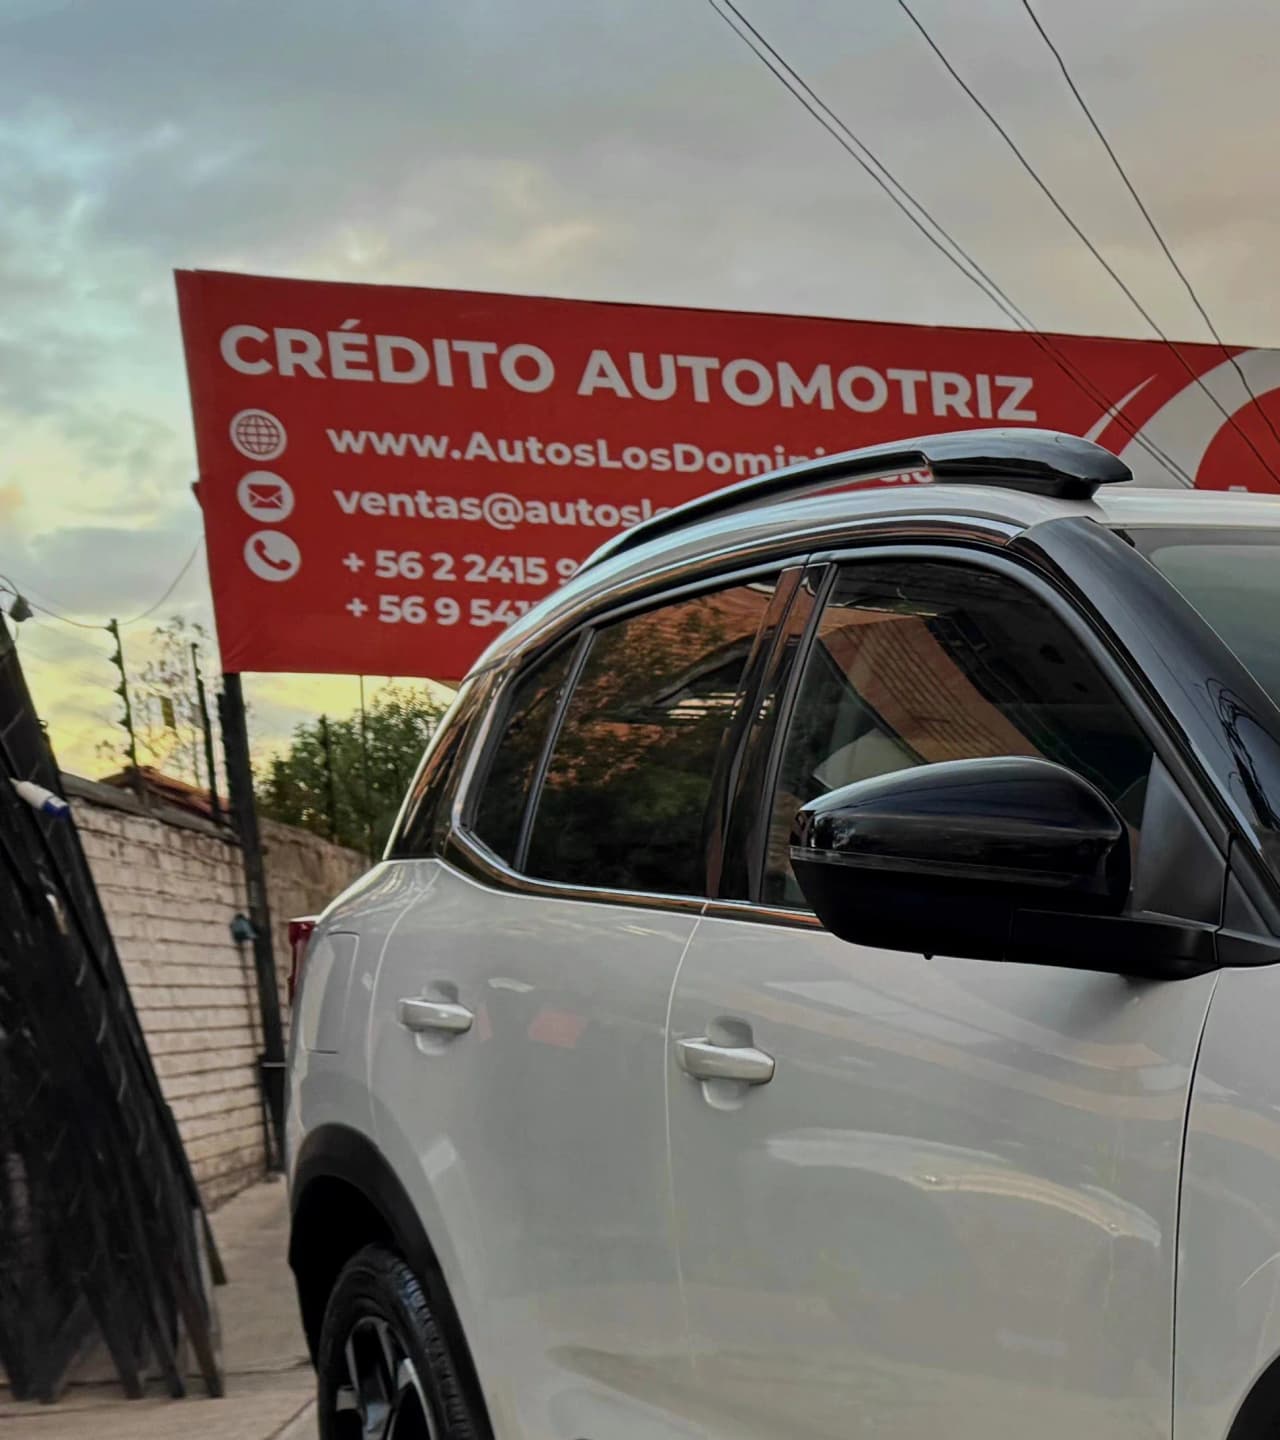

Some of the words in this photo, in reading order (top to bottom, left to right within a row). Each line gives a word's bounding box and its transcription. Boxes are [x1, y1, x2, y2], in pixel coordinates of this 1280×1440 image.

[219, 319, 555, 394] CRÉDITO
[578, 350, 1038, 422] AUTOMOTRIZ
[375, 550, 424, 580] 56
[430, 552, 456, 581] 2
[463, 553, 549, 585] 2415
[378, 594, 428, 624] 56
[434, 597, 460, 626] 9
